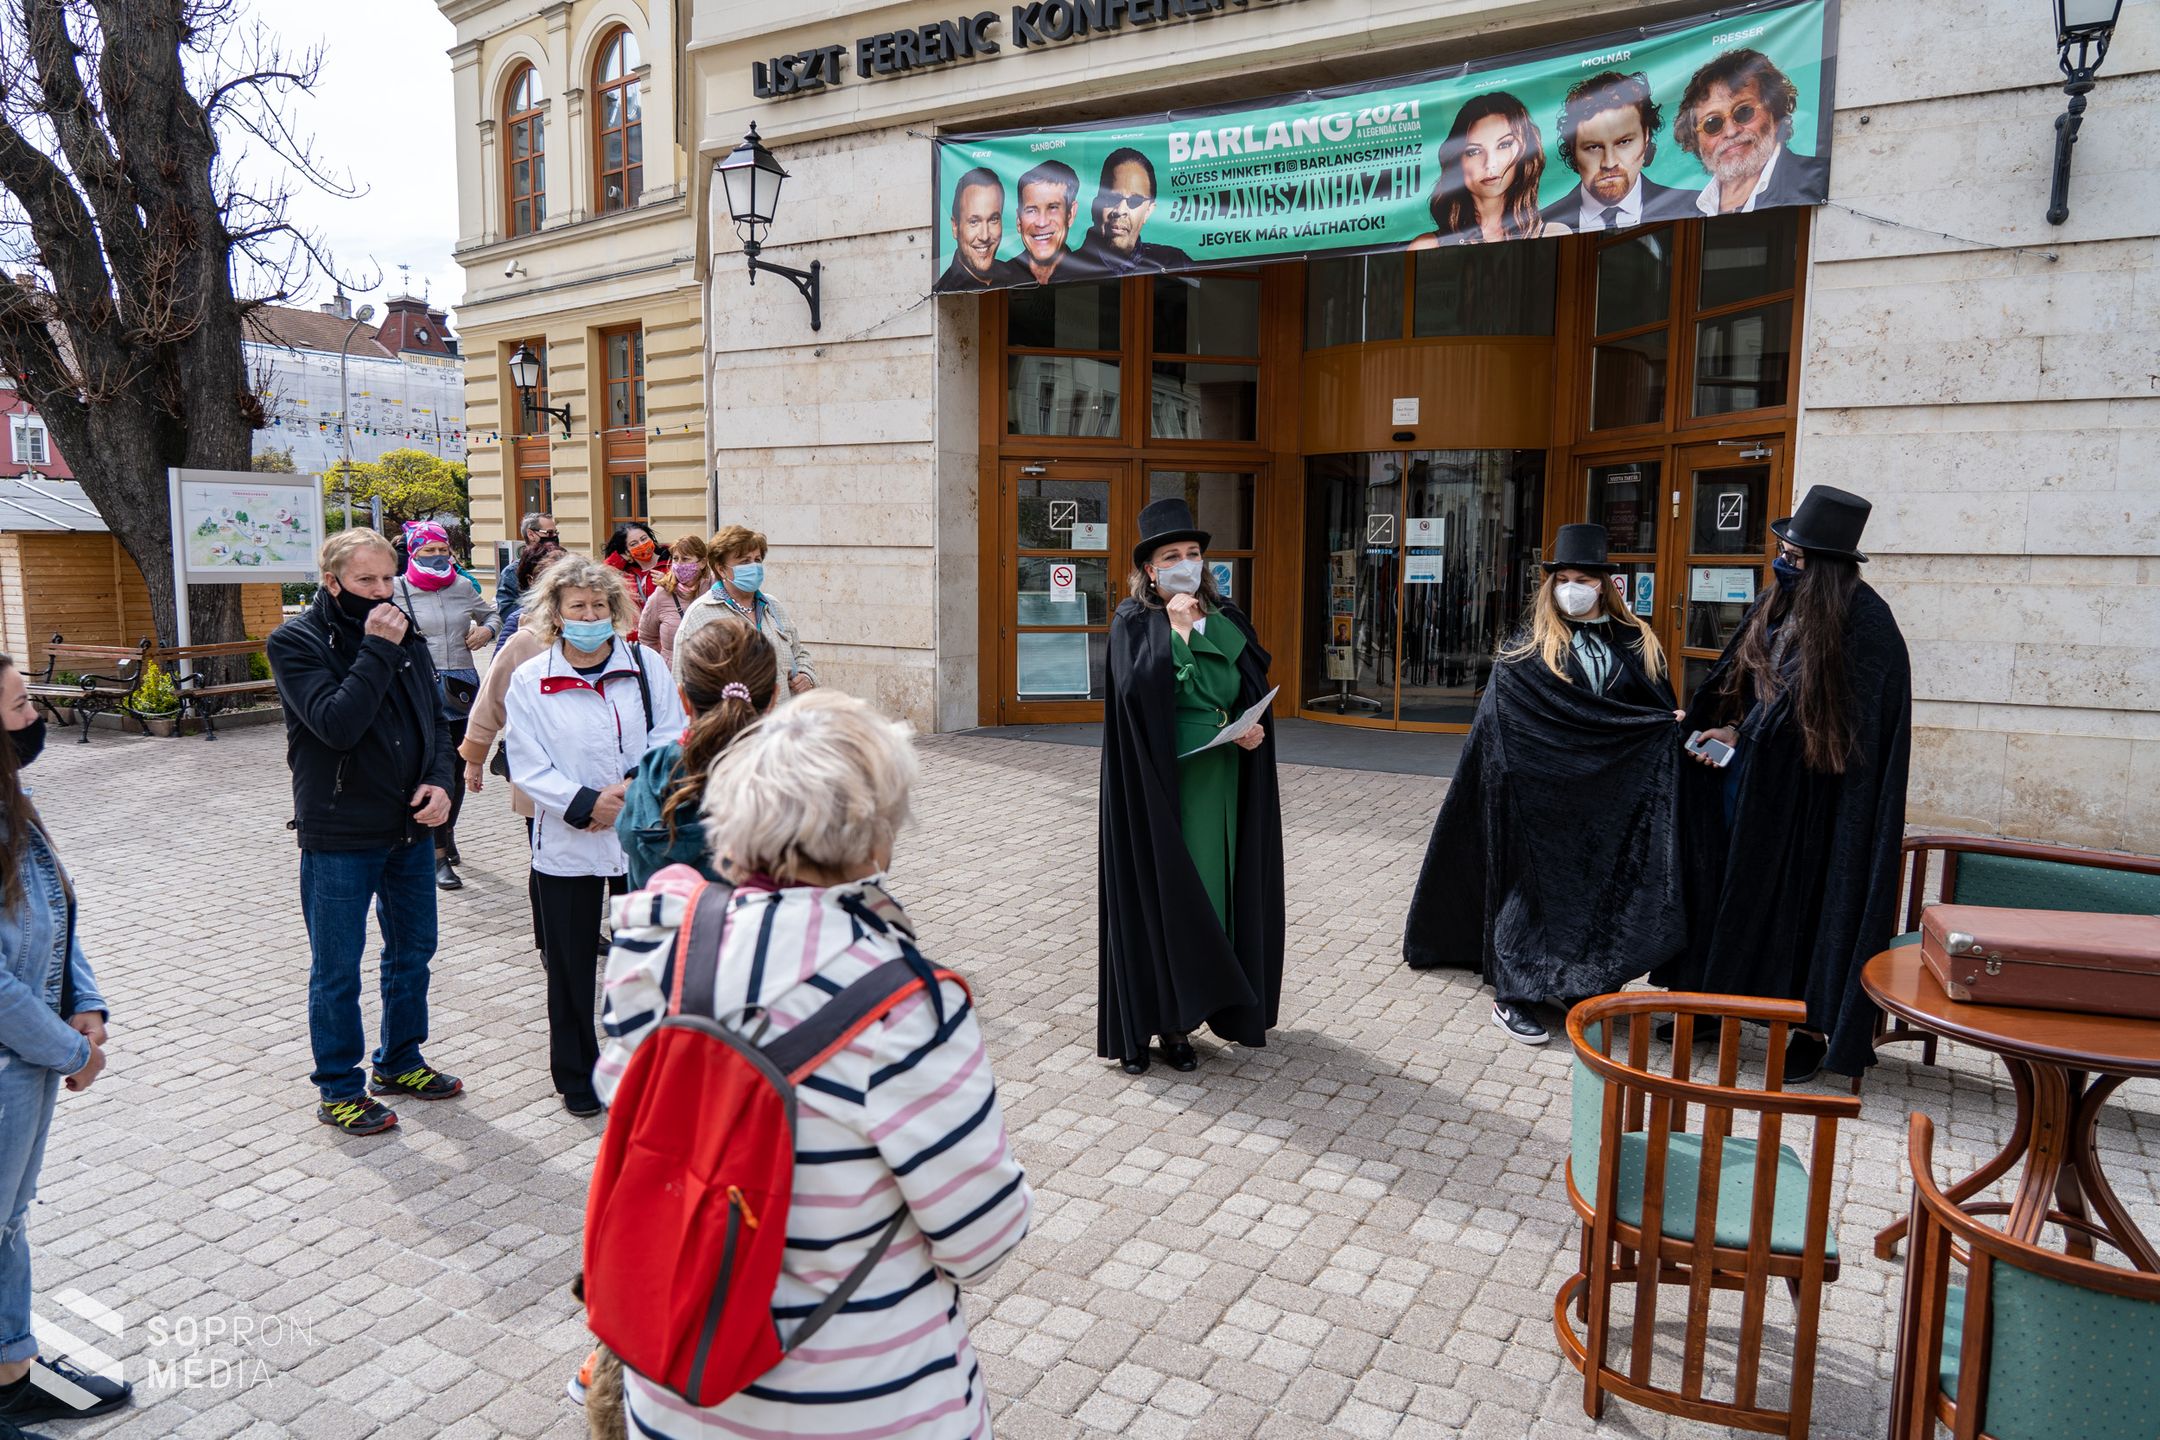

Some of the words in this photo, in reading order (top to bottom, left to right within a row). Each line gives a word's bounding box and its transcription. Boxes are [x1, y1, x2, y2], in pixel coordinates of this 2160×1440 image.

[1712, 25, 1764, 46] PRESSER
[752, 44, 847, 98] LISZT
[856, 10, 1001, 79] FERENC
[1581, 50, 1631, 68] MOLNÁR
[1168, 111, 1353, 164] BARLANG
[1355, 99, 1420, 128] 2021
[1357, 128, 1363, 139] A
[1363, 123, 1397, 138] LEGENDÁK
[1030, 139, 1066, 152] SANBORN
[1171, 170, 1219, 187] KÖVESS
[1222, 163, 1272, 181] MINKET!
[1300, 143, 1422, 171] BARLANGSZINHAZ
[1199, 230, 1252, 247] JEGYEK
[1256, 225, 1288, 241] MÁR
[1293, 213, 1386, 238] VÁLTHATÓK!
